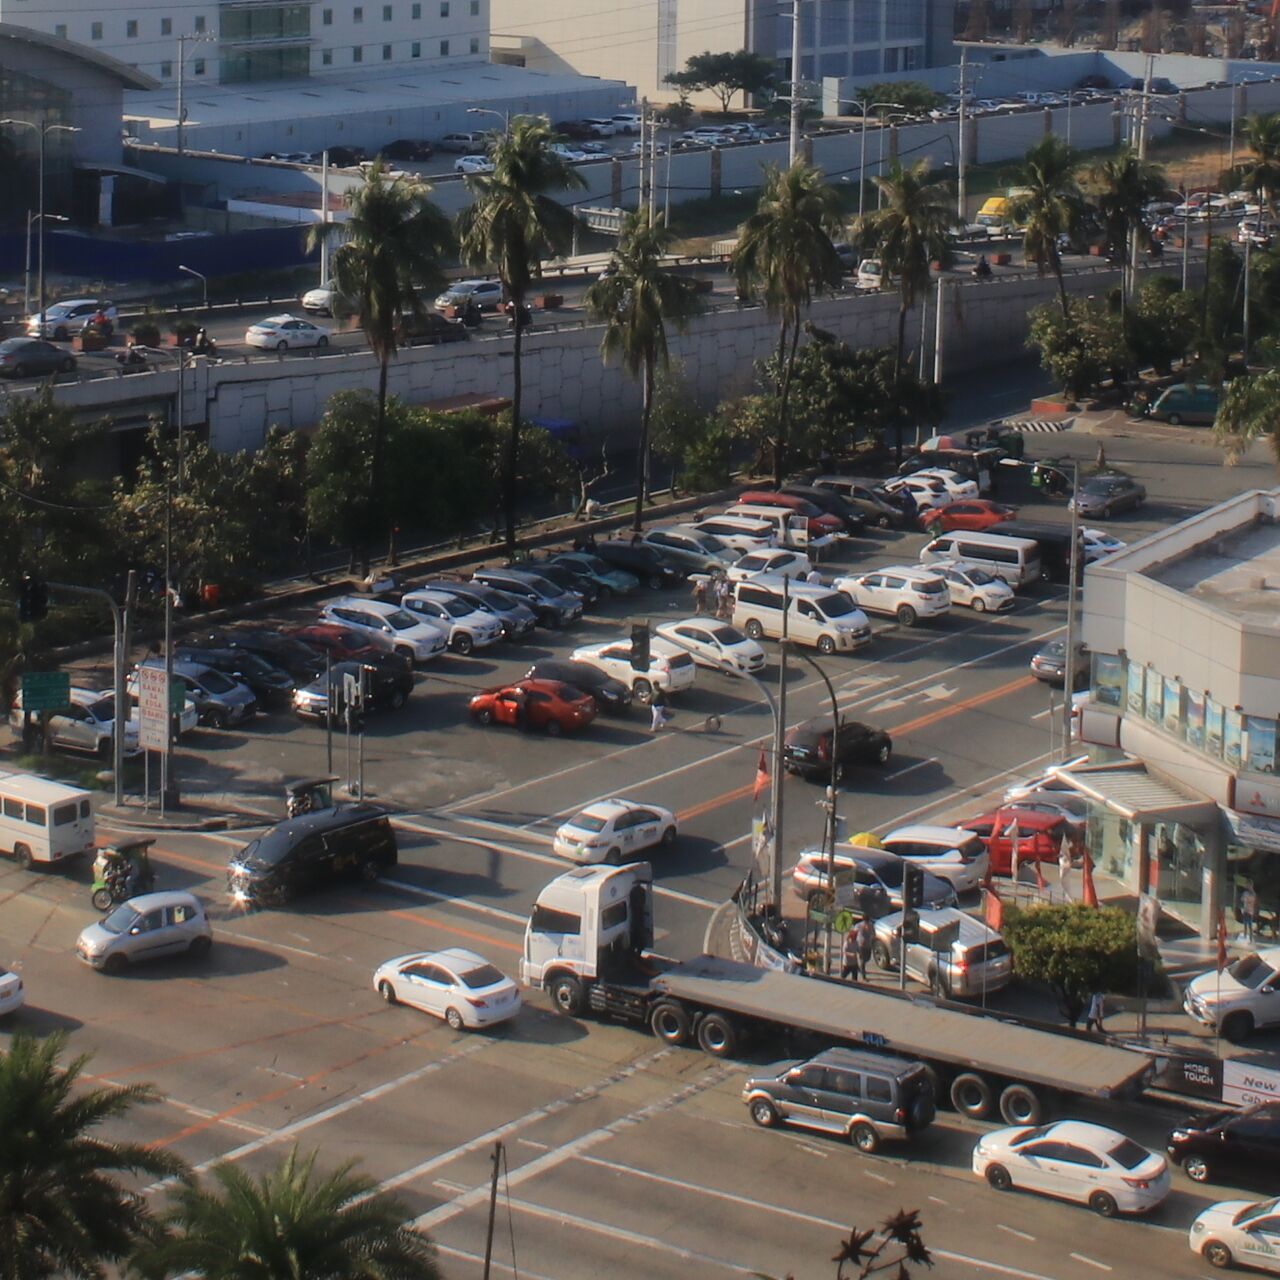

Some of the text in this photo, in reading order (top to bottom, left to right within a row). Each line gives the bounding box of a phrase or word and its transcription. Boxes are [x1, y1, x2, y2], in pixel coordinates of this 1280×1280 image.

[1184, 1062, 1210, 1074] MORE
[1183, 1071, 1214, 1085] TOUGH
[1243, 1076, 1278, 1092] New
